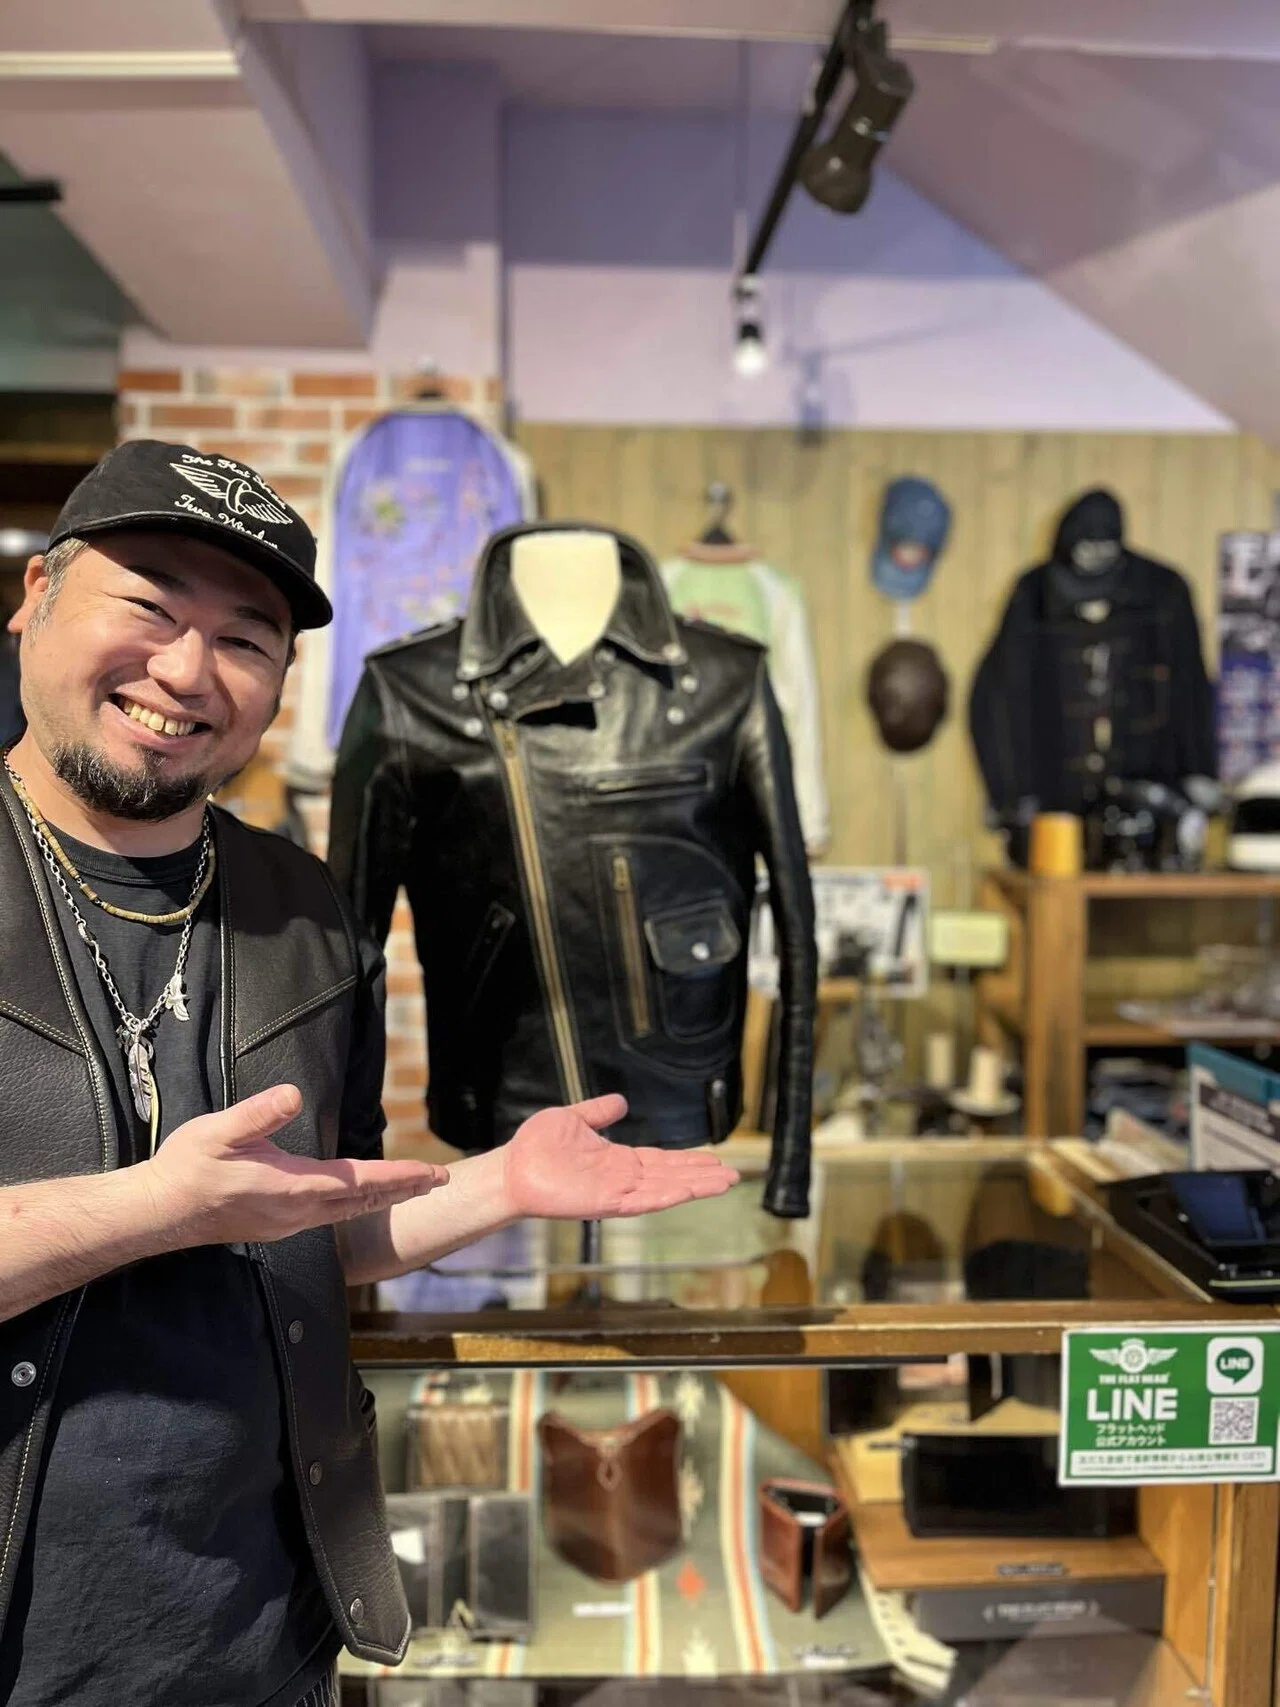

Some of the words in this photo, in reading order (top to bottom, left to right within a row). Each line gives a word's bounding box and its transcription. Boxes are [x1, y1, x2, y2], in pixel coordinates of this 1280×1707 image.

[181, 453, 213, 466] The
[217, 458, 251, 478] Flat
[1220, 1356, 1250, 1370] LINE
[1087, 1388, 1179, 1420] LINE
